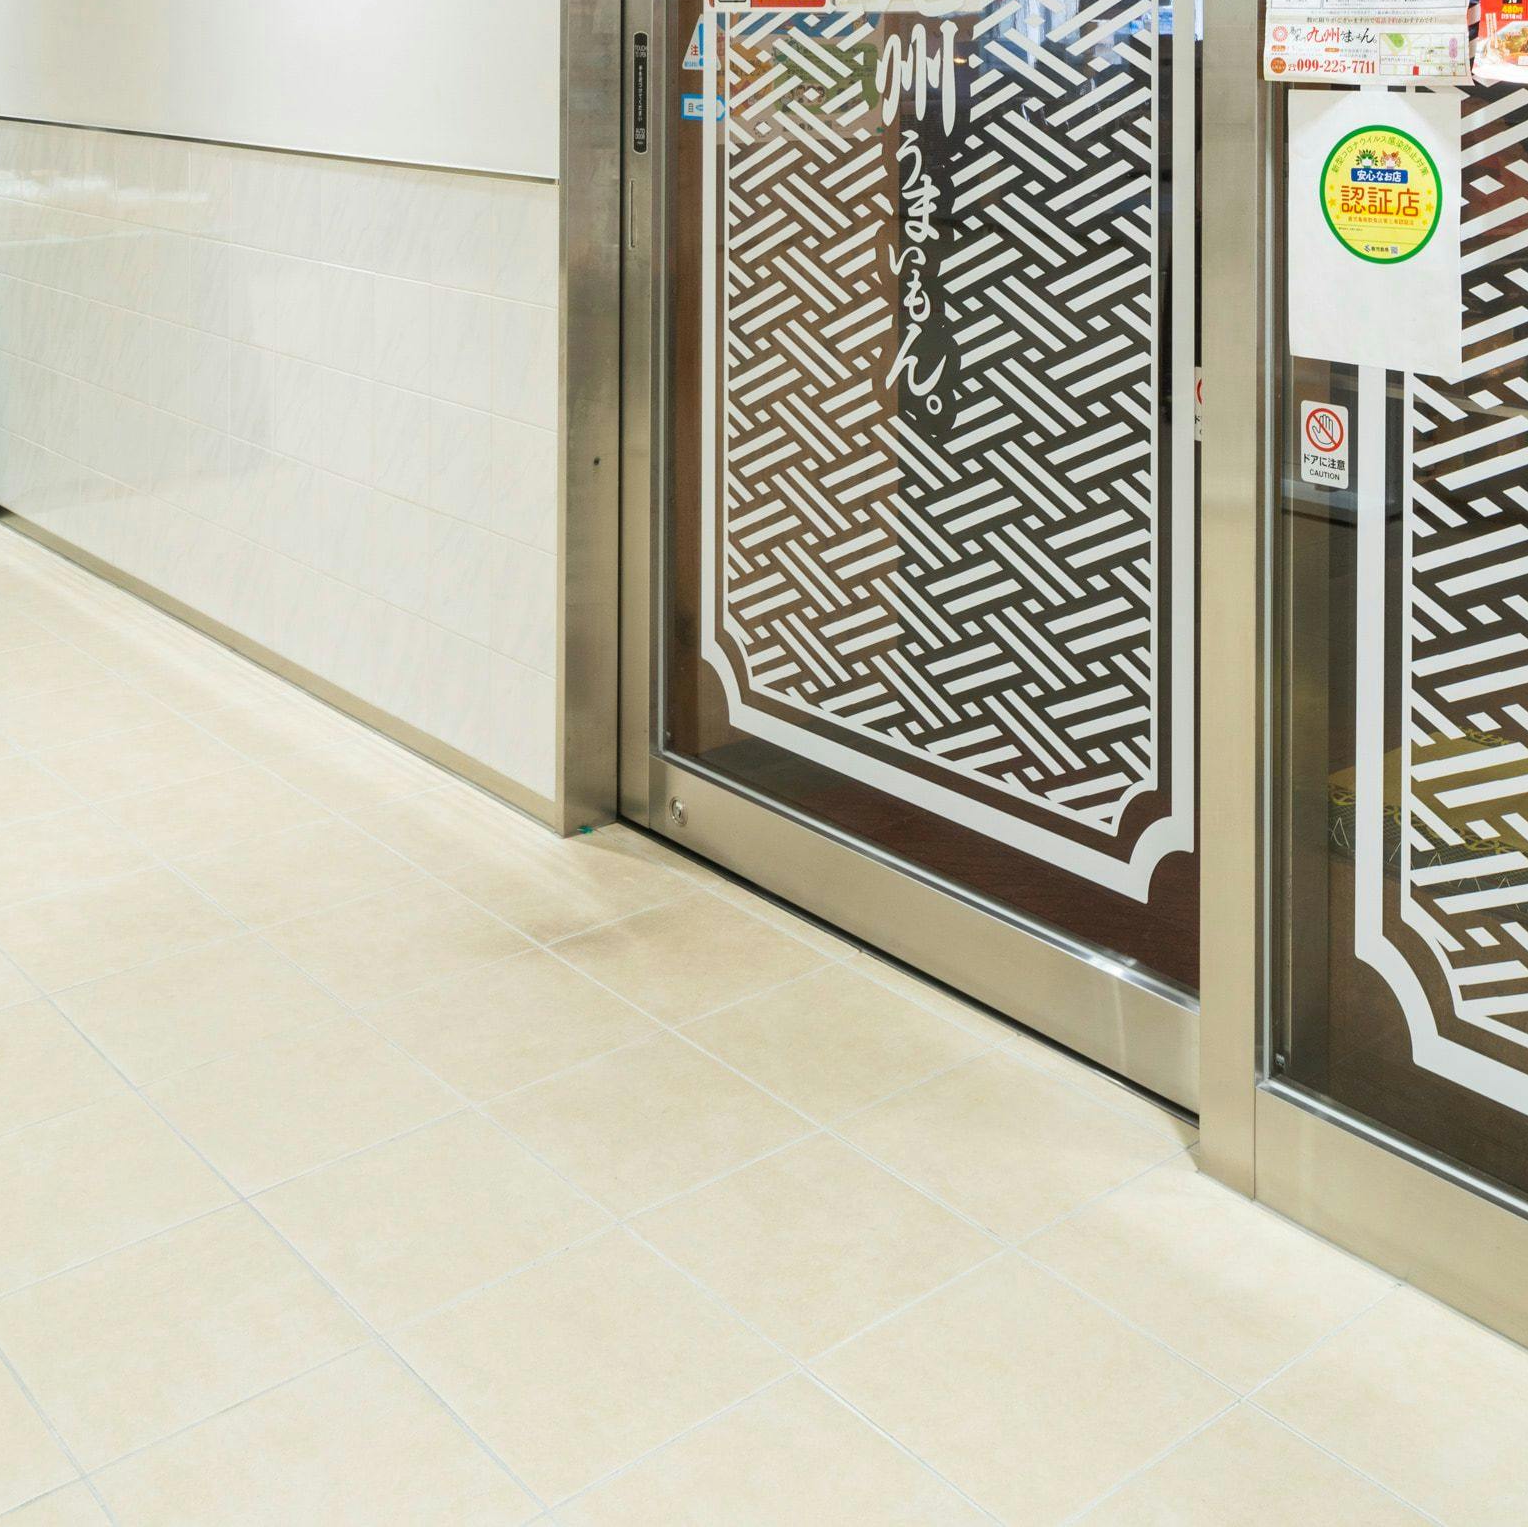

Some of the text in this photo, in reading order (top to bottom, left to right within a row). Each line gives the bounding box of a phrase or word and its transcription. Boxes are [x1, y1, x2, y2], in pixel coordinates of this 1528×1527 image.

[1296, 58, 1376, 74] 099-225-7711
[1357, 170, 1402, 182] 安心なお店
[1341, 185, 1420, 217] 認証店
[1303, 453, 1346, 471] ドアに注意
[1309, 468, 1340, 481] CAUTION
